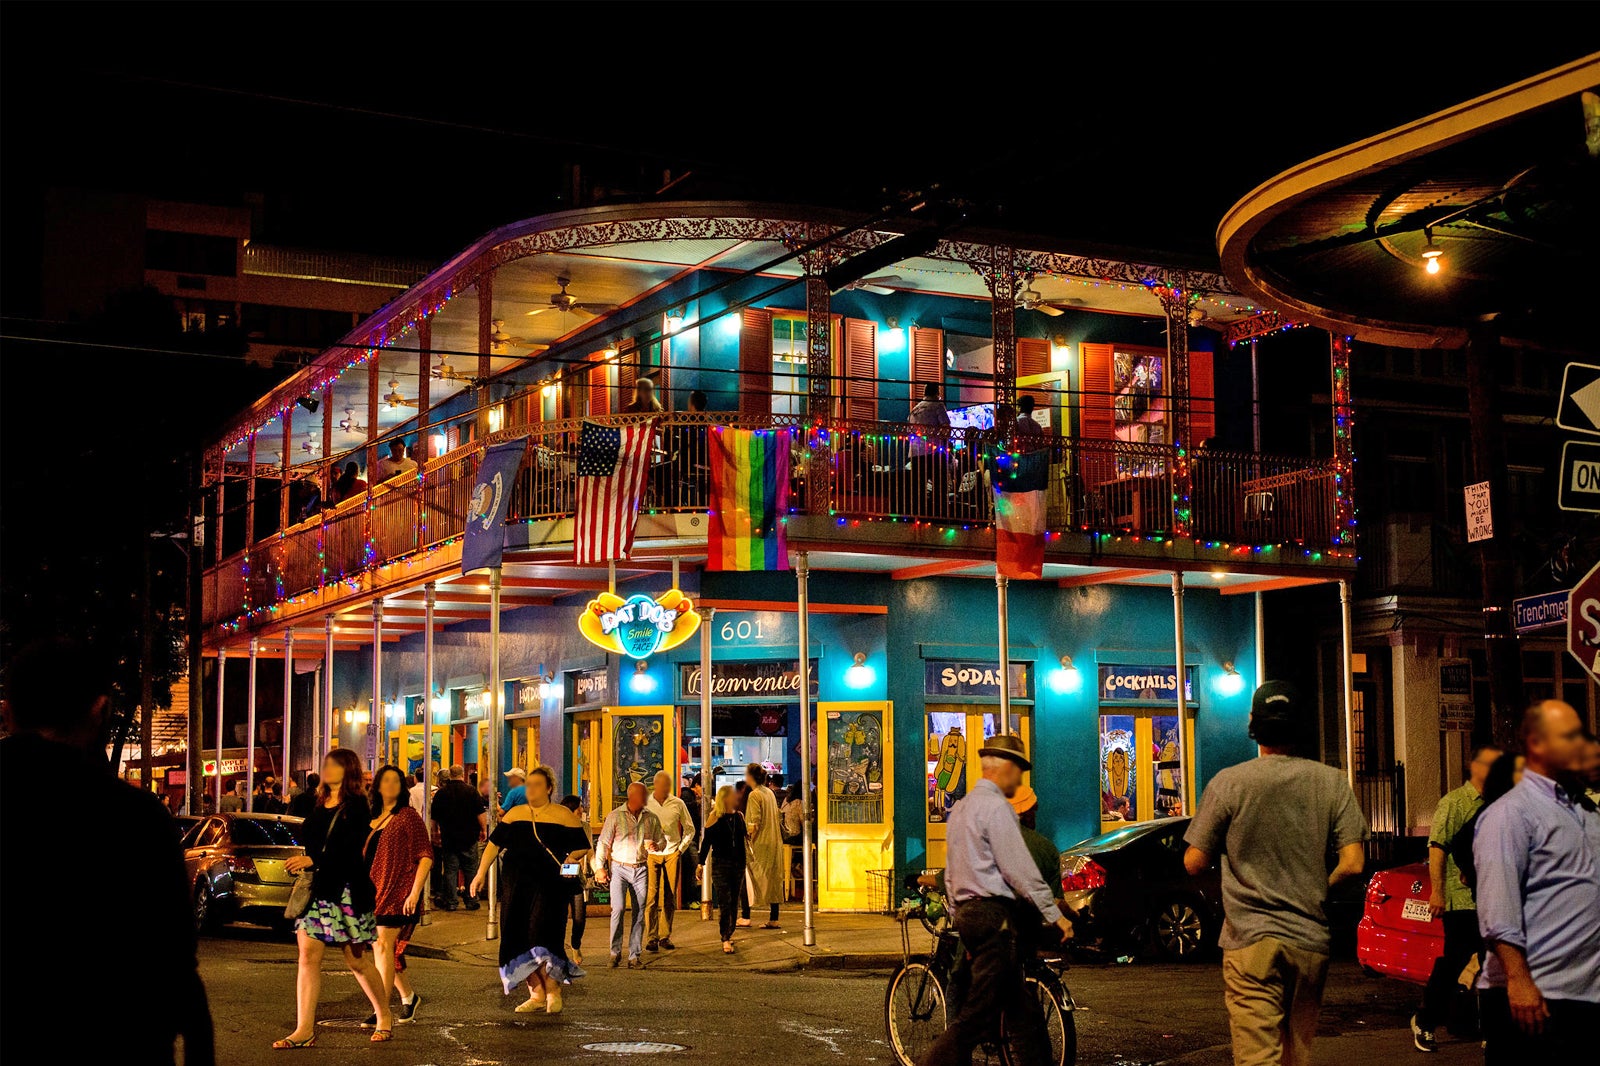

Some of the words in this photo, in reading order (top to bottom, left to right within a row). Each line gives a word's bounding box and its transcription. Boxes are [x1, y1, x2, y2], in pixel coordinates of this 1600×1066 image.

[1465, 483, 1490, 494] THINK
[1471, 491, 1487, 499] THAT
[1468, 498, 1489, 510] YOU
[1470, 507, 1489, 517] MIGHT
[1475, 515, 1485, 524] BE
[1468, 524, 1492, 539] WRONG
[627, 628, 653, 640] Smile
[721, 619, 764, 641] 601
[1105, 674, 1177, 691] COCKTAILS
